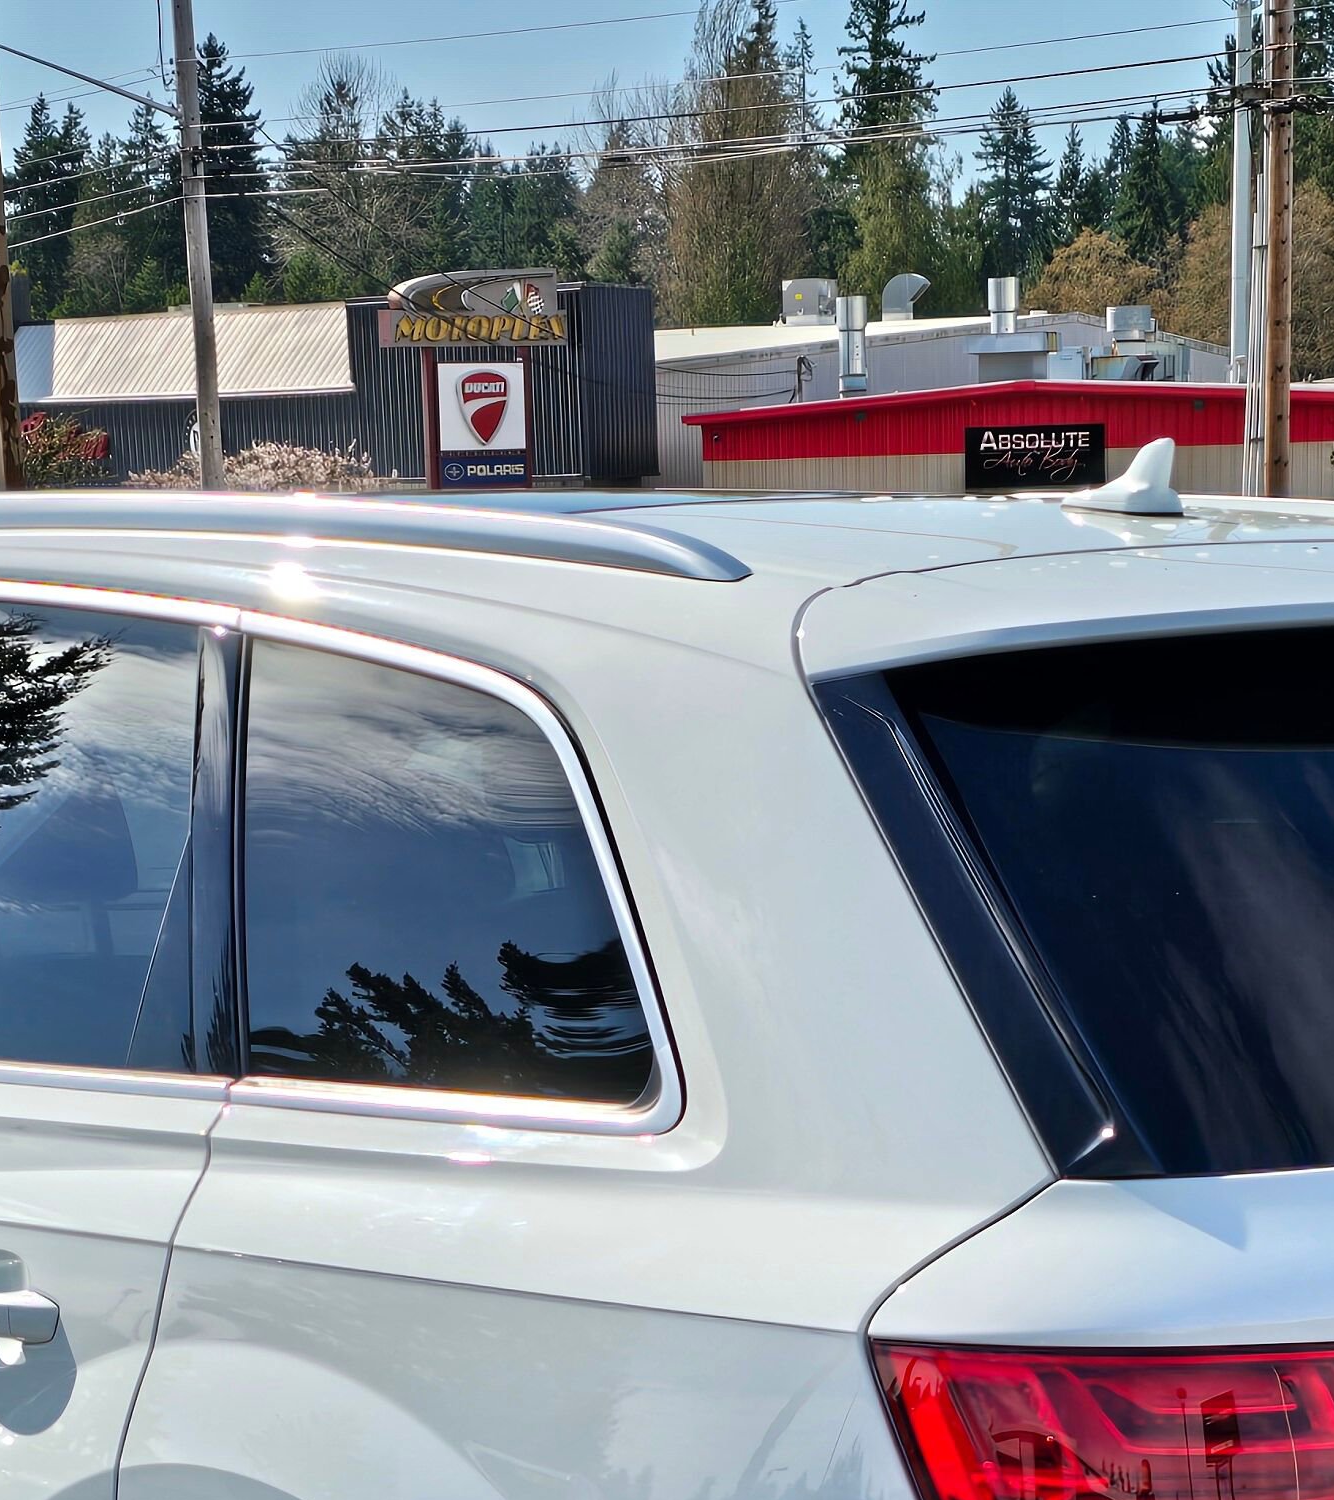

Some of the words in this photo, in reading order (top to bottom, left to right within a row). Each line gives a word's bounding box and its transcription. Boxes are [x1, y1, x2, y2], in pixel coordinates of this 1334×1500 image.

[394, 313, 566, 343] MOTOPLEX
[464, 382, 505, 393] DUCATI
[980, 431, 1090, 450] ABSOLUTE
[467, 464, 525, 477] POLARIS
[983, 450, 1040, 476] Auto
[1038, 444, 1080, 481] Body
